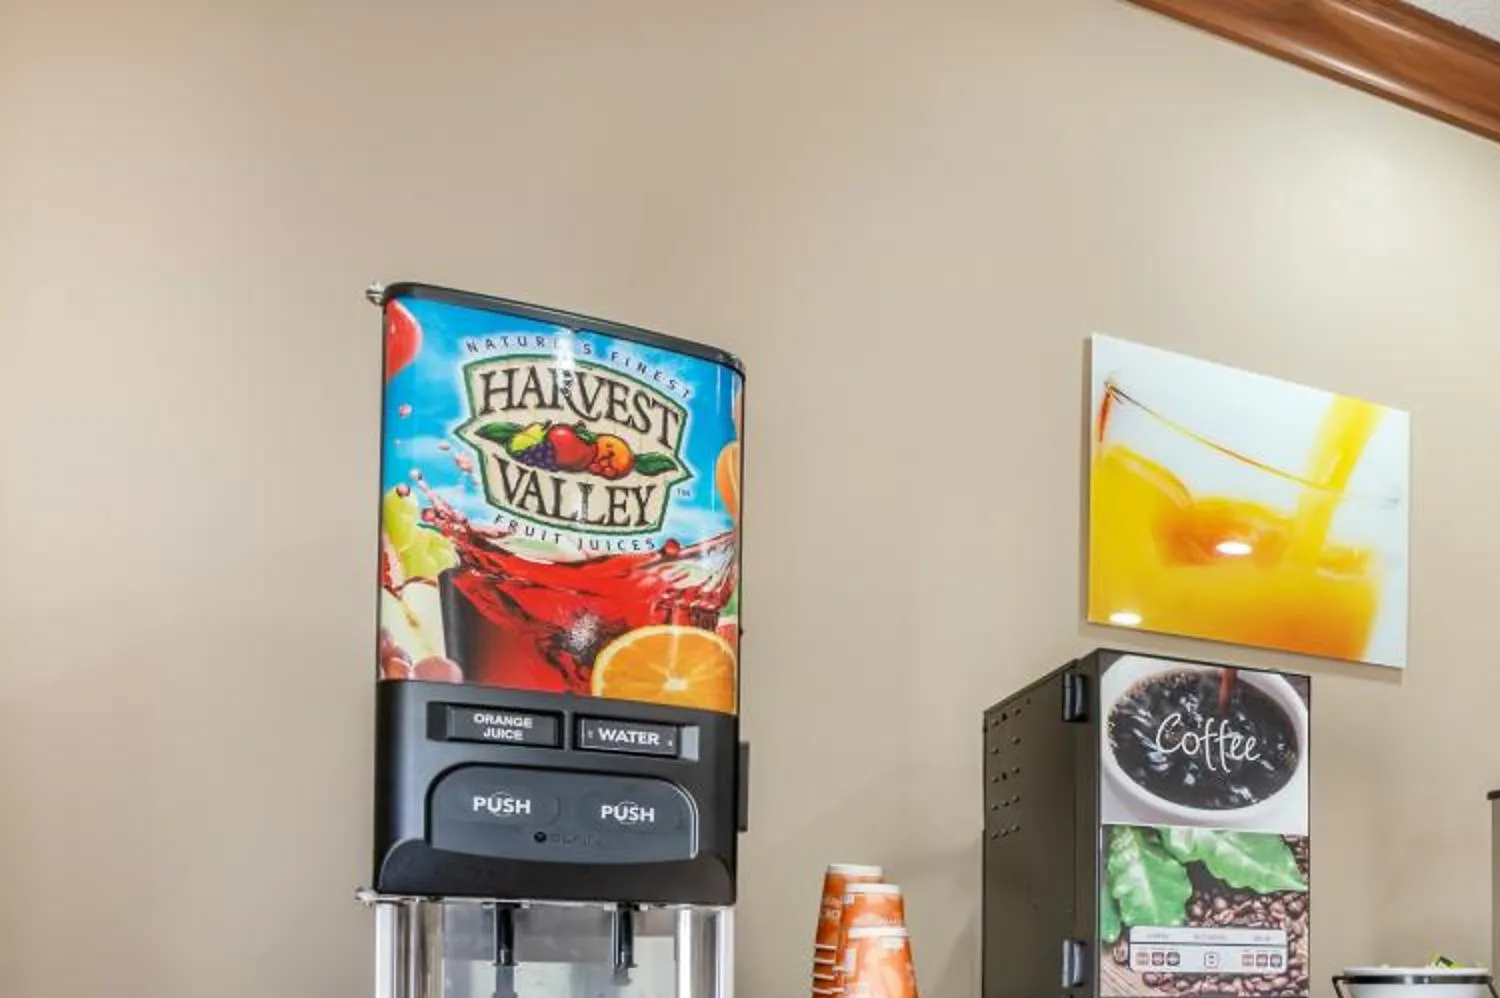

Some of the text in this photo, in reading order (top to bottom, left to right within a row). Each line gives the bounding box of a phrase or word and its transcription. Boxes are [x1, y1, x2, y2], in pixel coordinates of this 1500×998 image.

[466, 335, 690, 399] NATURS FINEST
[479, 365, 679, 450] HARVEST
[493, 454, 657, 527] VALLEY
[494, 514, 656, 551] FRUIT JUICES
[473, 712, 533, 729] ORANGE
[482, 728, 524, 742] JUICE
[597, 727, 660, 746] WATER
[1155, 712, 1261, 773] Coffee
[472, 796, 531, 815] PUSH
[600, 804, 656, 823] PUSH
